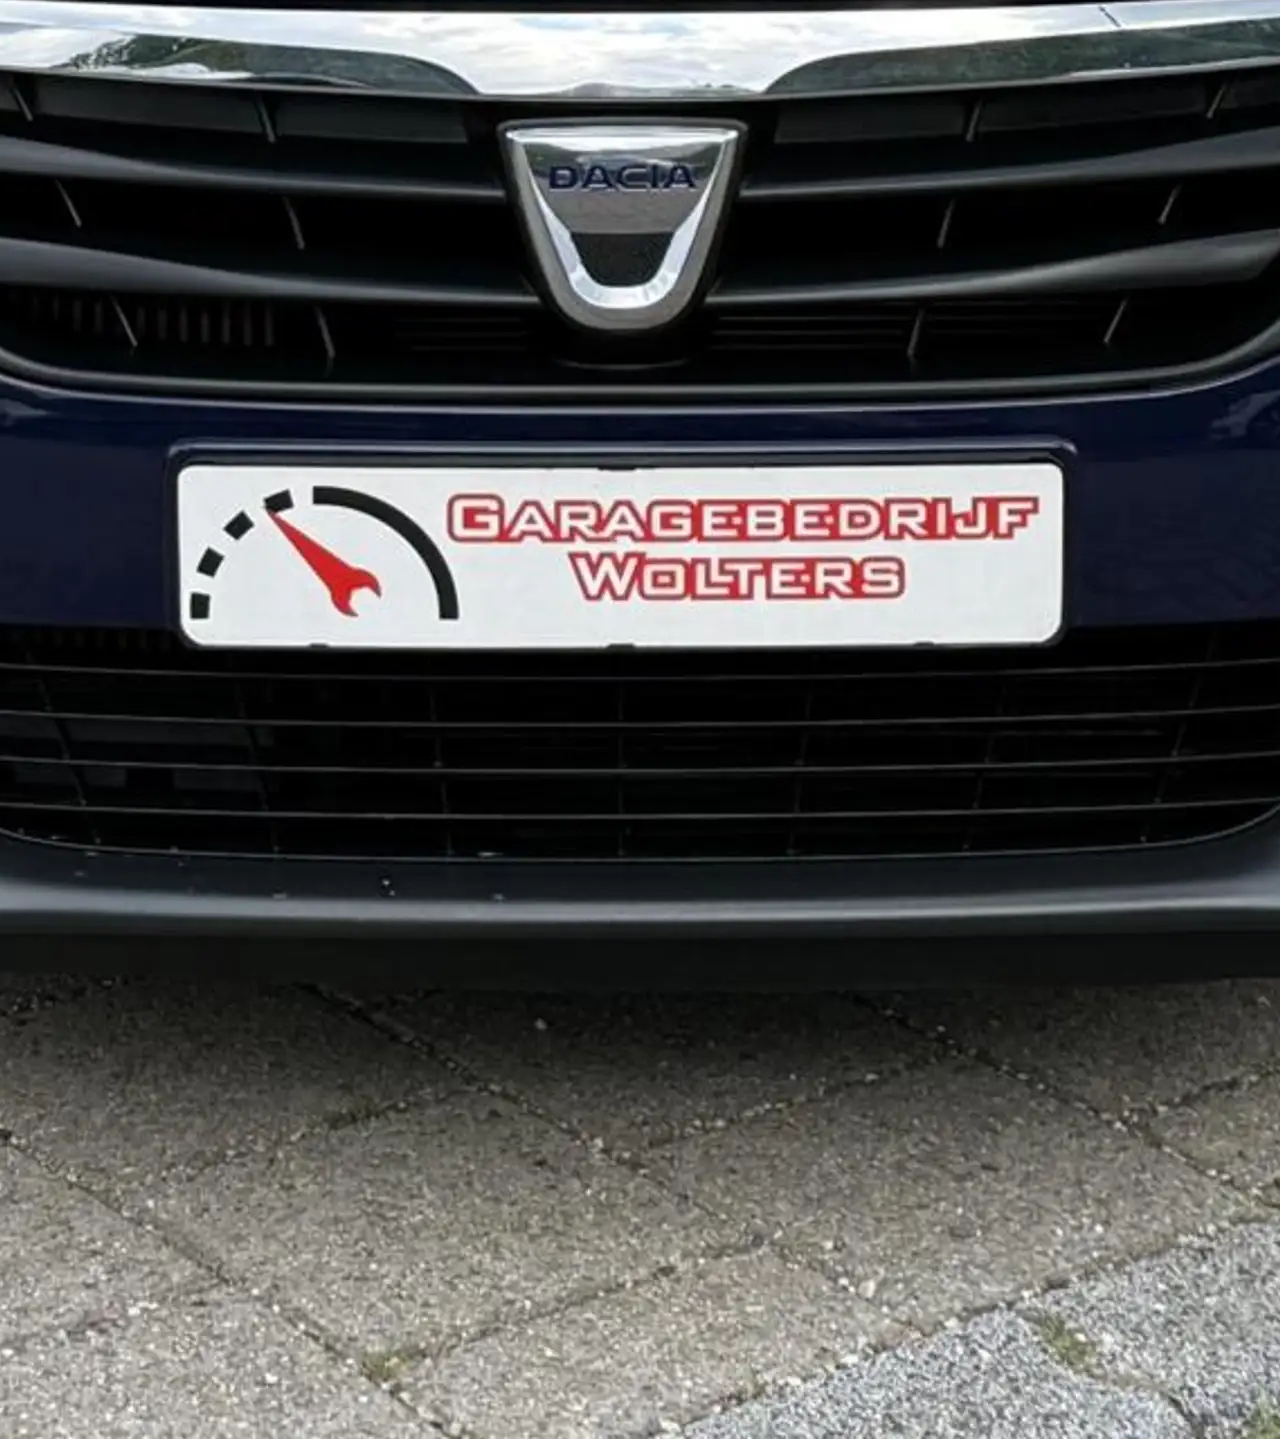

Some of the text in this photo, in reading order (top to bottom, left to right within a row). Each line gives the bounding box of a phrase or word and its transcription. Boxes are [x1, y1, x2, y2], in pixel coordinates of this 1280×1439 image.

[548, 164, 698, 191] DACIA
[447, 494, 1039, 544] GARAGEBEDRIJF
[568, 551, 907, 601] WOLTERS
